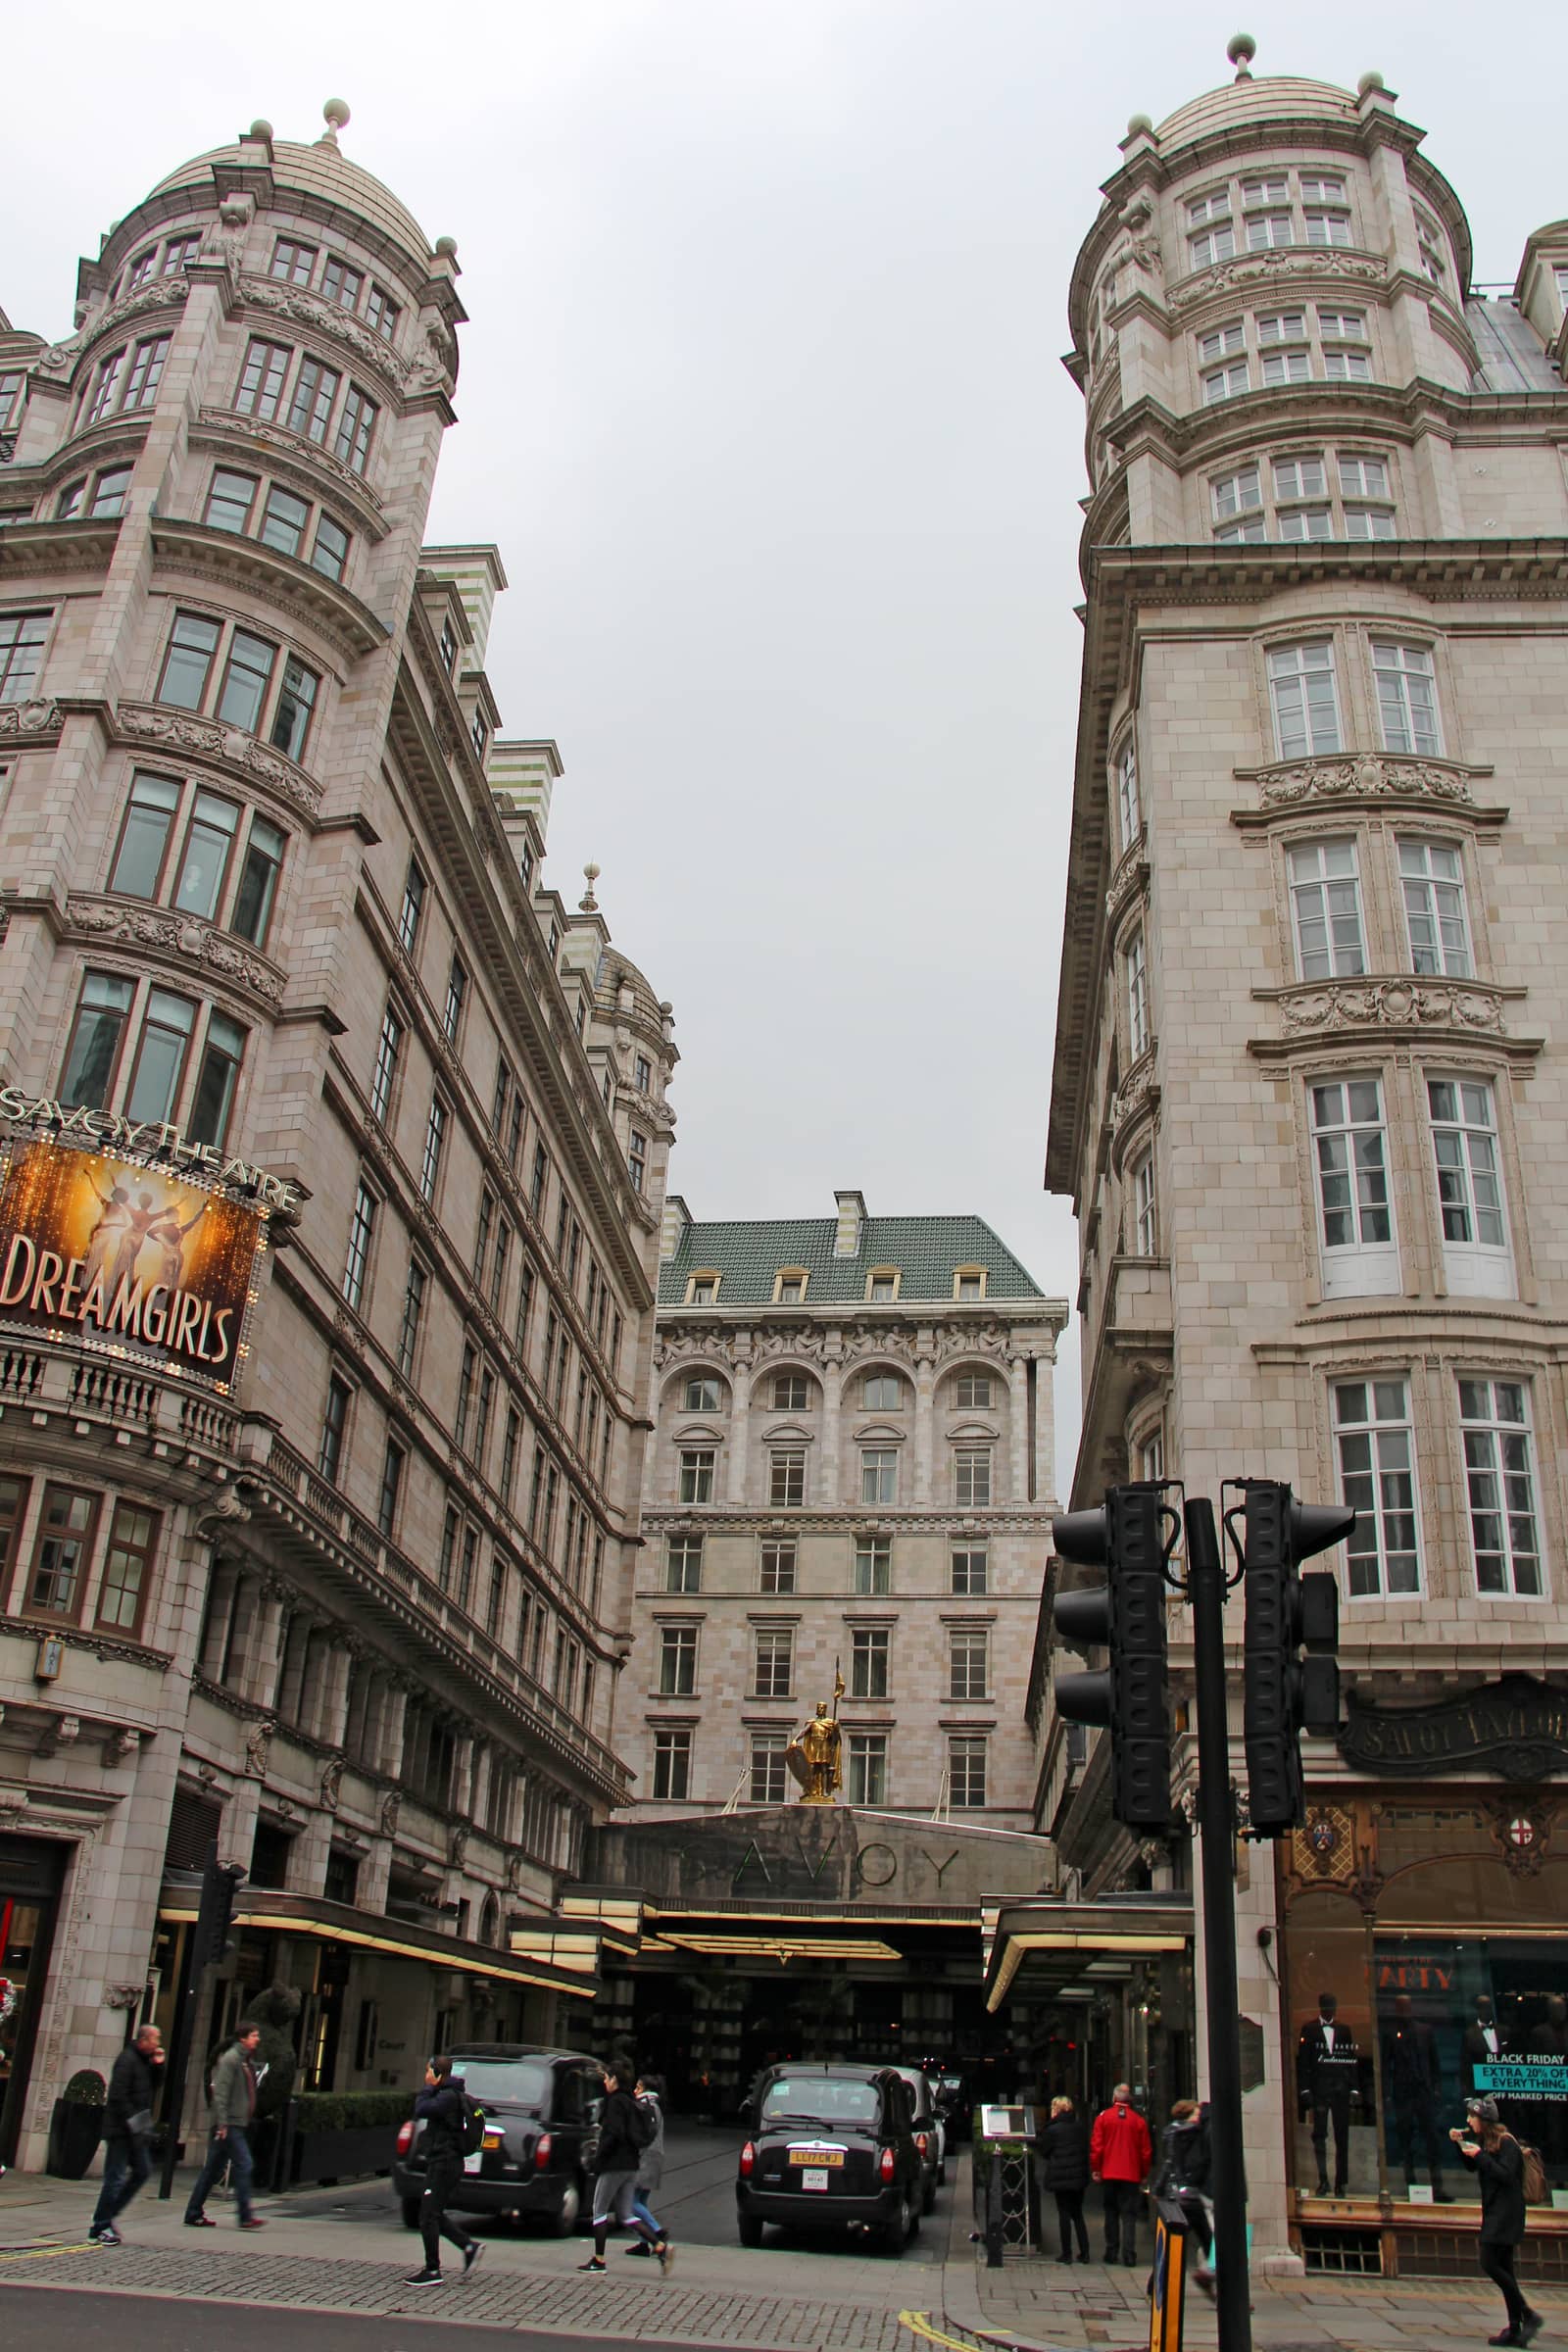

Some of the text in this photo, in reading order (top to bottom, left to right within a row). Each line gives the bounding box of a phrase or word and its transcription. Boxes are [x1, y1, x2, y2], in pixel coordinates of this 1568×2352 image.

[0, 1087, 301, 1215] SAVOY THEATRE
[0, 1232, 234, 1364] DREAMGIRLS
[1363, 1719, 1452, 1757] SAVOY
[680, 1836, 959, 1888] SAVOY
[1486, 2053, 1566, 2065] BLACK FRIDAY
[1482, 2066, 1523, 2077] EXTRA
[1526, 2067, 1547, 2079] 20%
[1492, 2077, 1567, 2089] EVERYTHING
[1507, 2092, 1544, 2101] MARKED
